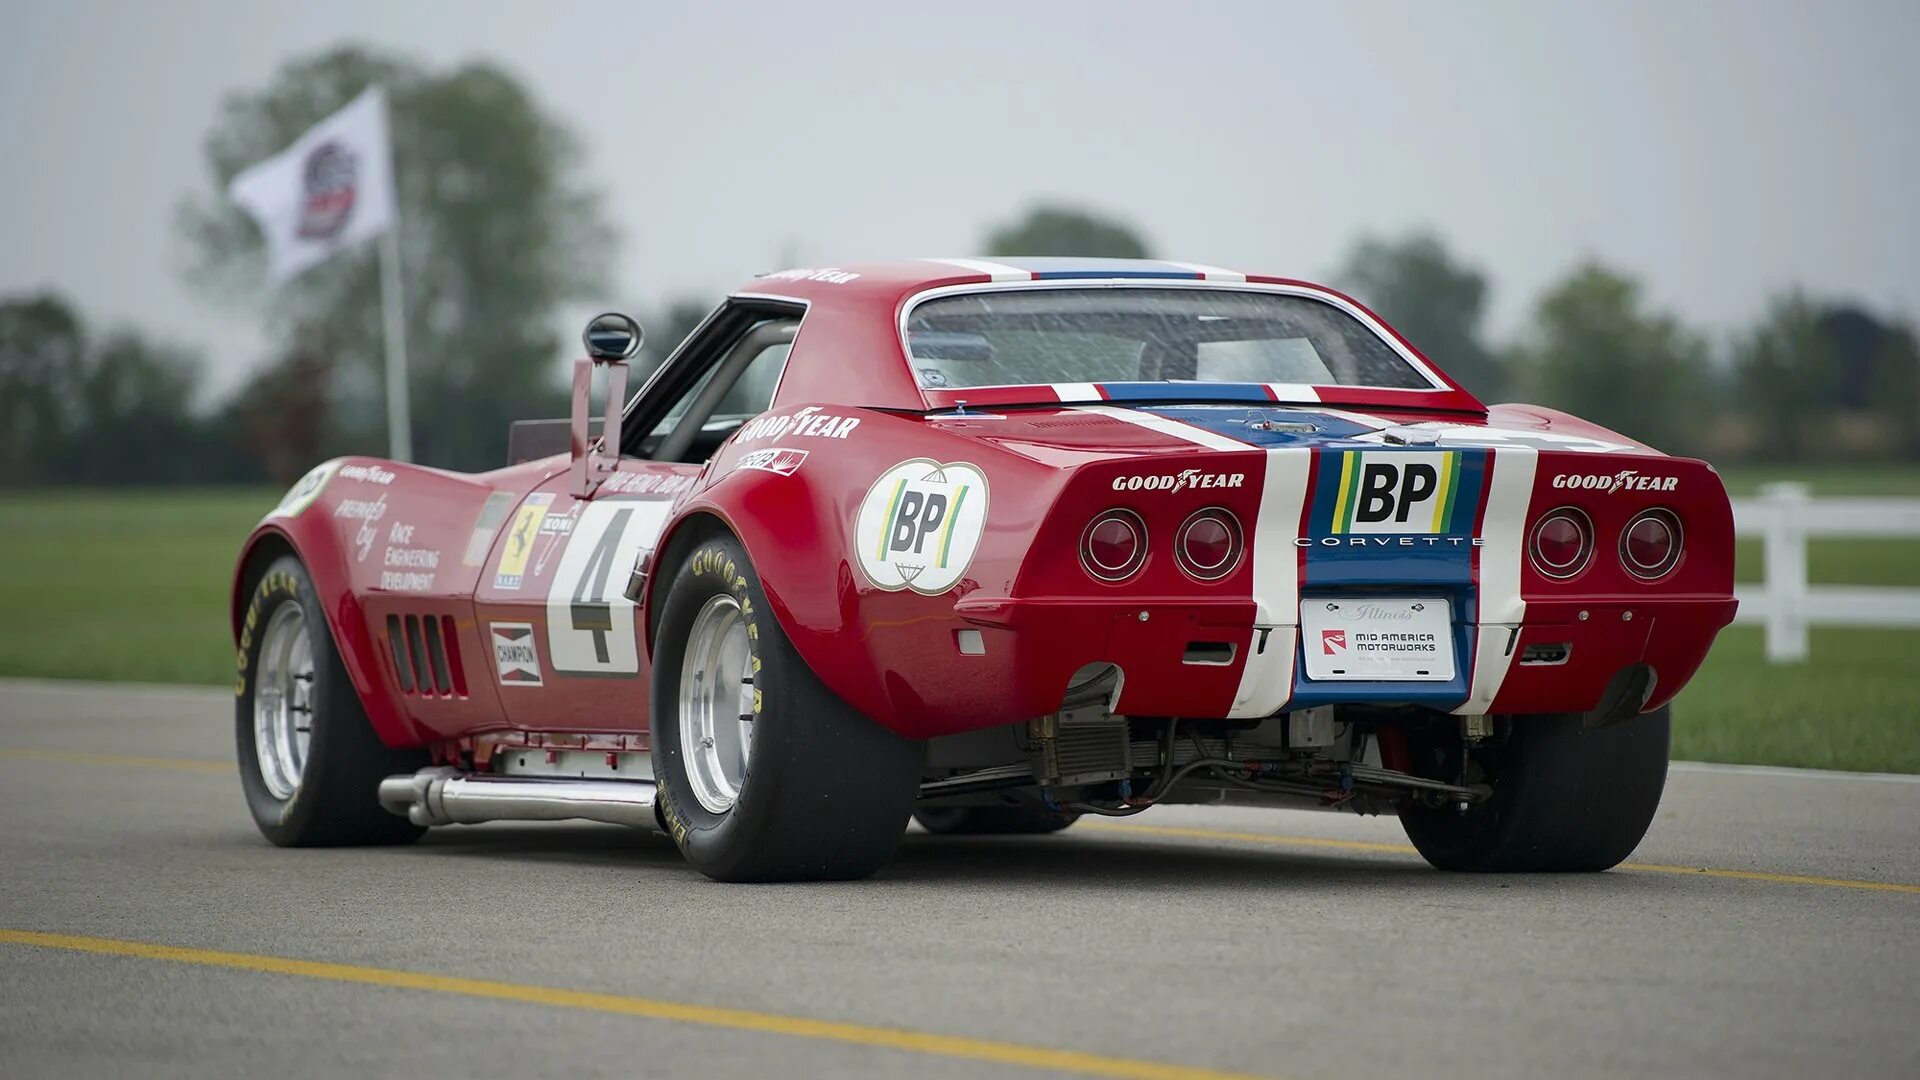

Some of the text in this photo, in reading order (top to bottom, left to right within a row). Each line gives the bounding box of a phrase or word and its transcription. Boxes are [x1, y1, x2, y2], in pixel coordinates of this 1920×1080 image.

[1355, 463, 1438, 523] BP
[542, 517, 573, 532] KONI
[890, 490, 947, 554] BP
[1293, 537, 1485, 547] CORVETTE
[570, 508, 636, 663] 4
[1338, 604, 1414, 621] Illinois
[1355, 633, 1435, 642] MID AMERICA
[497, 645, 534, 663] CHAMPION
[1357, 643, 1436, 652] MOTORWORKS
